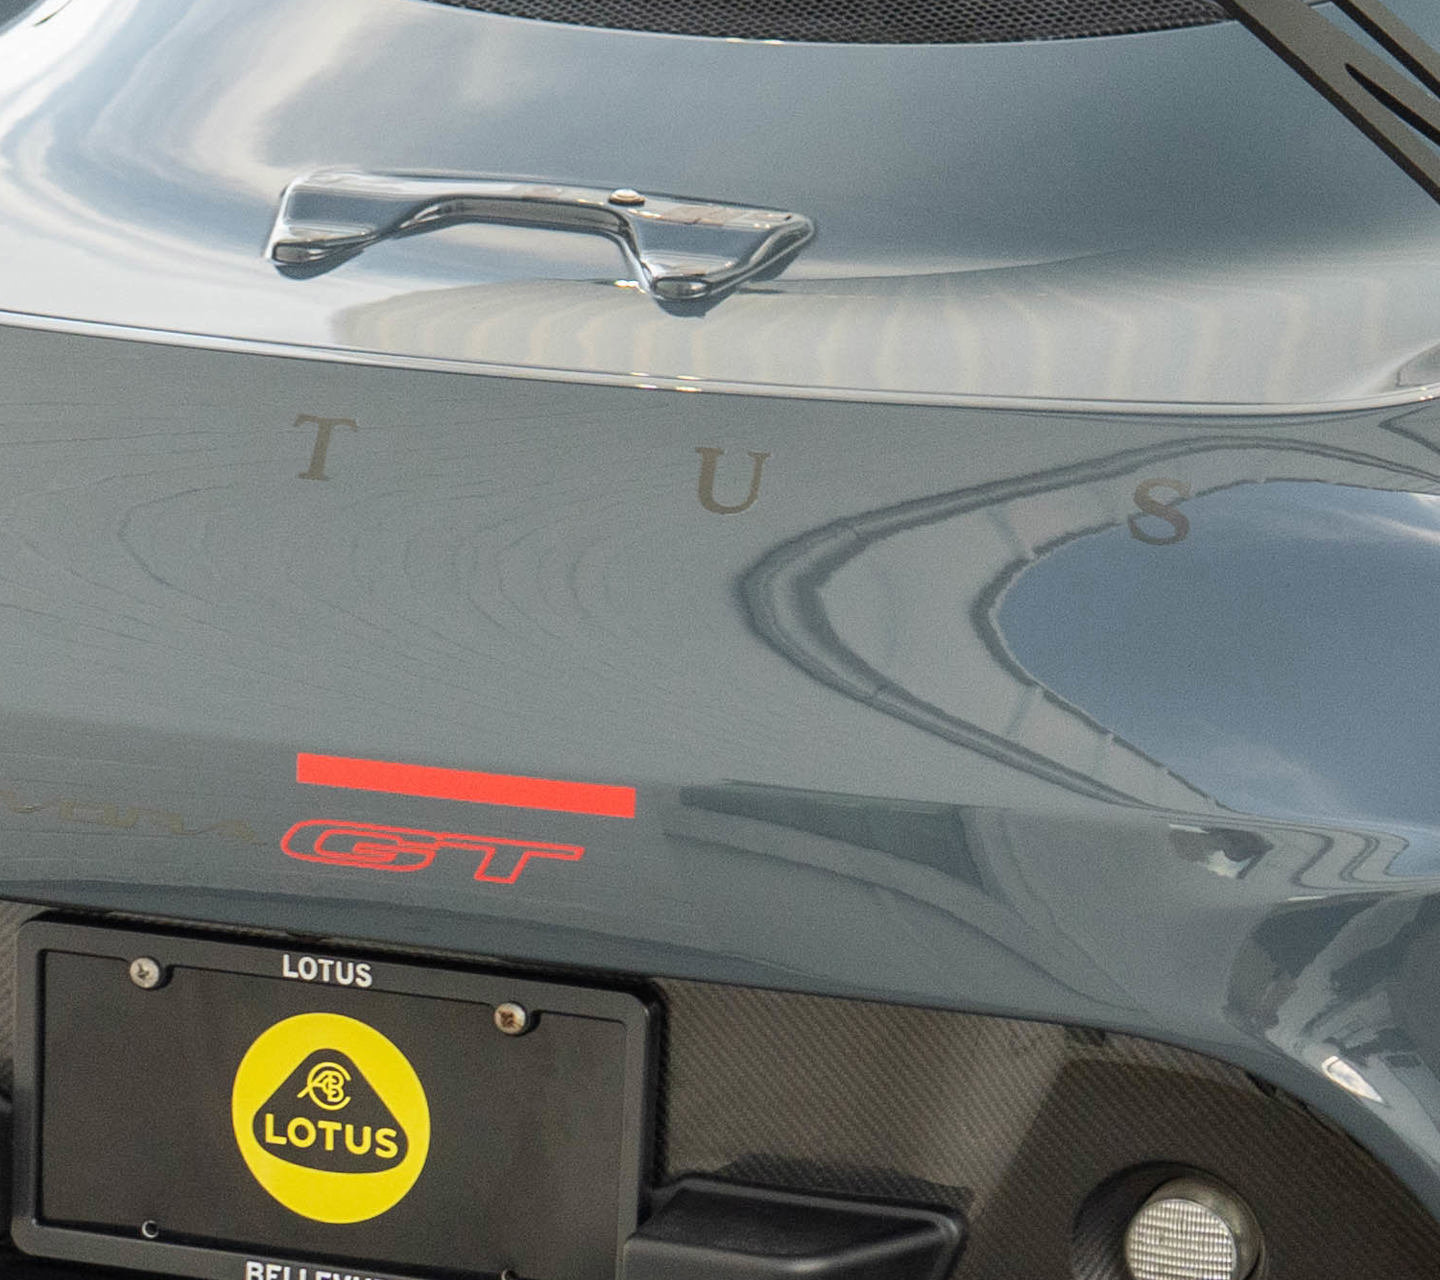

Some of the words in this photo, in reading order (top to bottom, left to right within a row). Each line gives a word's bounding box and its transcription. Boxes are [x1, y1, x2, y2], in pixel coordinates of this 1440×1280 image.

[280, 818, 586, 884] GT
[281, 953, 374, 988] LOTUS
[263, 1112, 400, 1159] LOTUS
